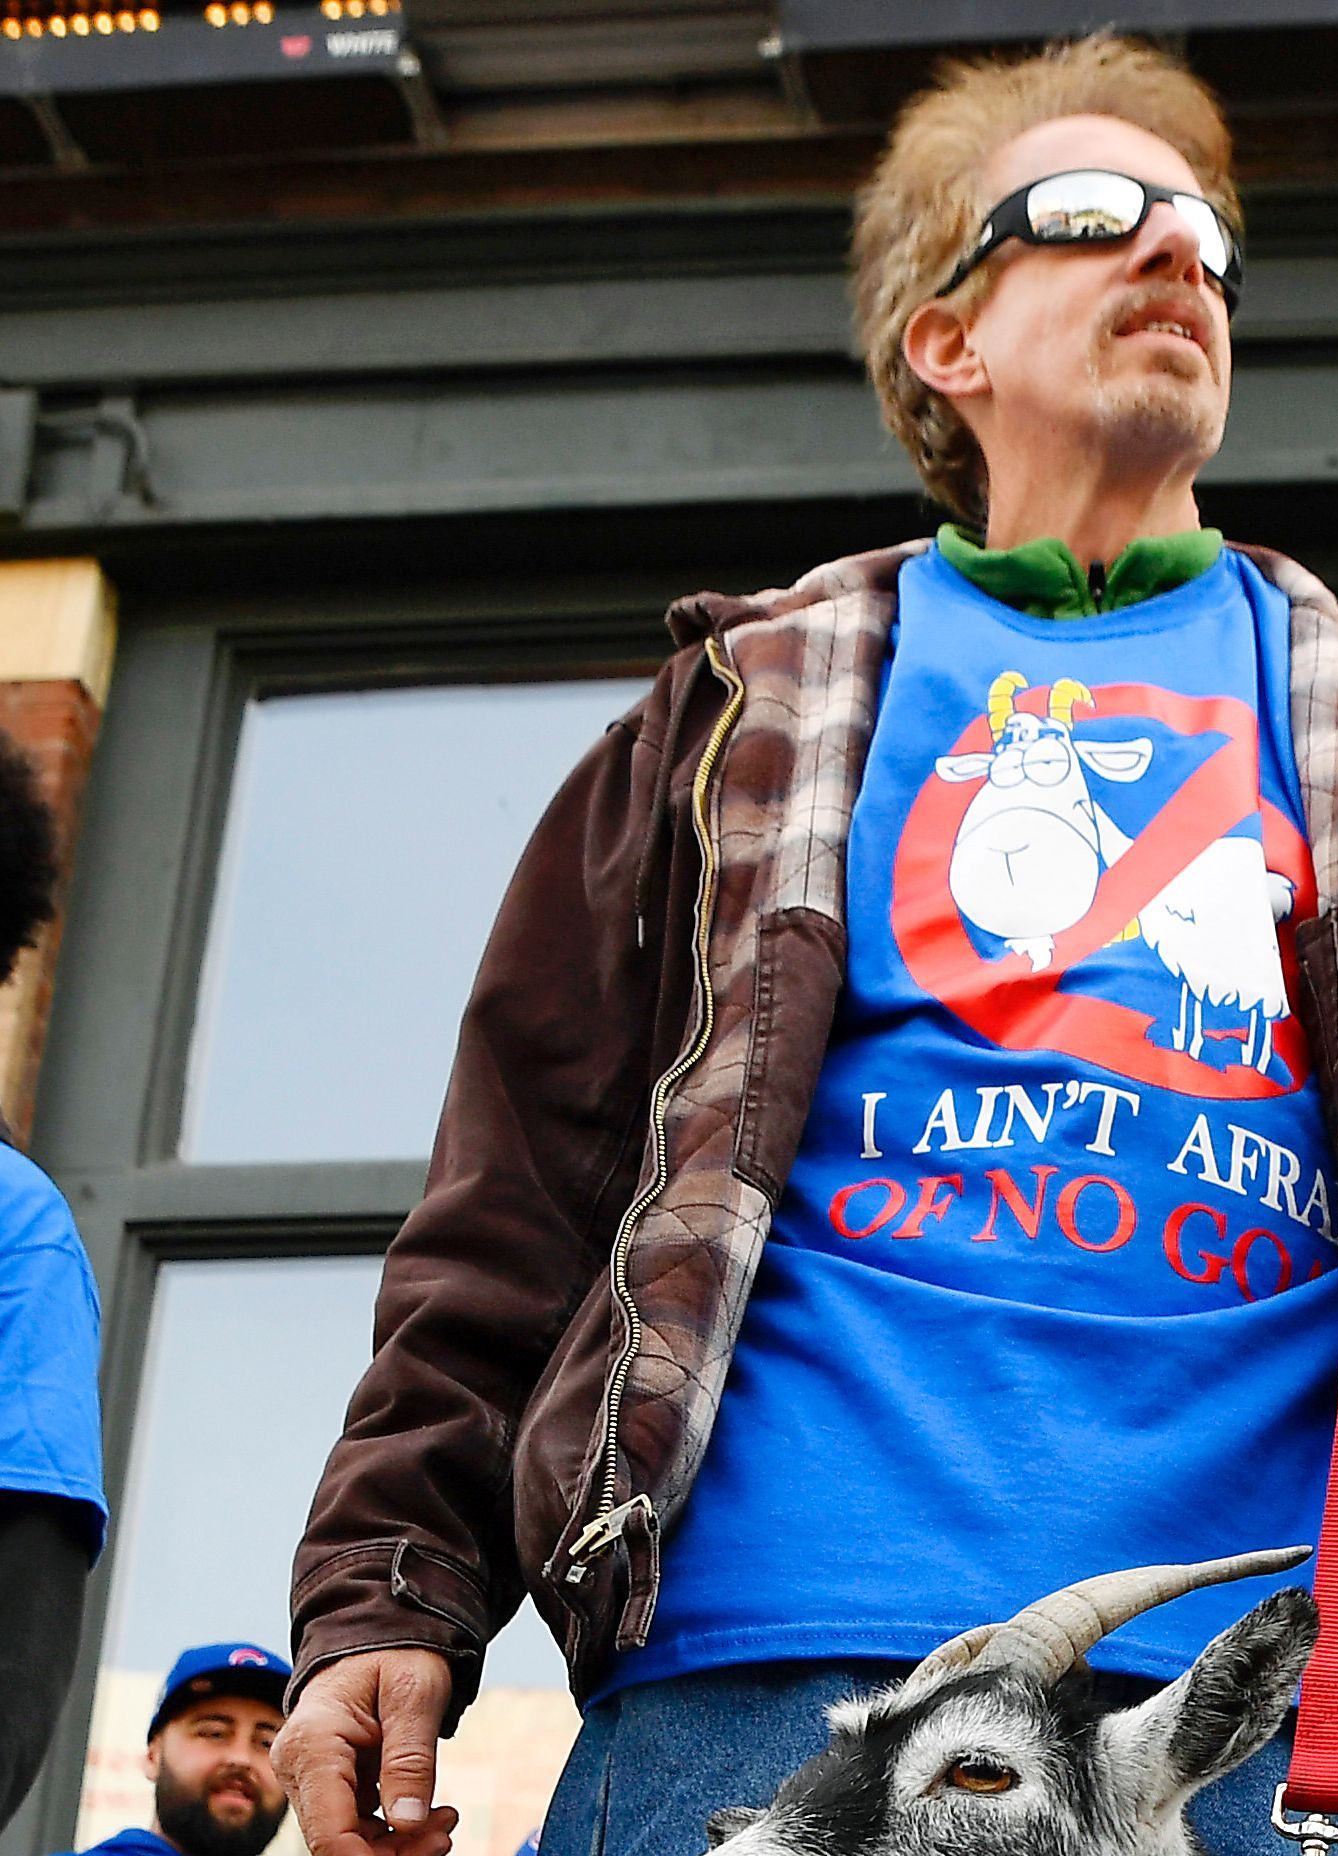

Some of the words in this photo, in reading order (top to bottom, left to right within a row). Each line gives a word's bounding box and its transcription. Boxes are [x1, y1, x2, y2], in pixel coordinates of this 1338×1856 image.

[860, 1092, 887, 1159] I
[912, 1080, 1140, 1157] AIN'T
[828, 1173, 964, 1240] OF
[970, 1164, 1138, 1253] NO
